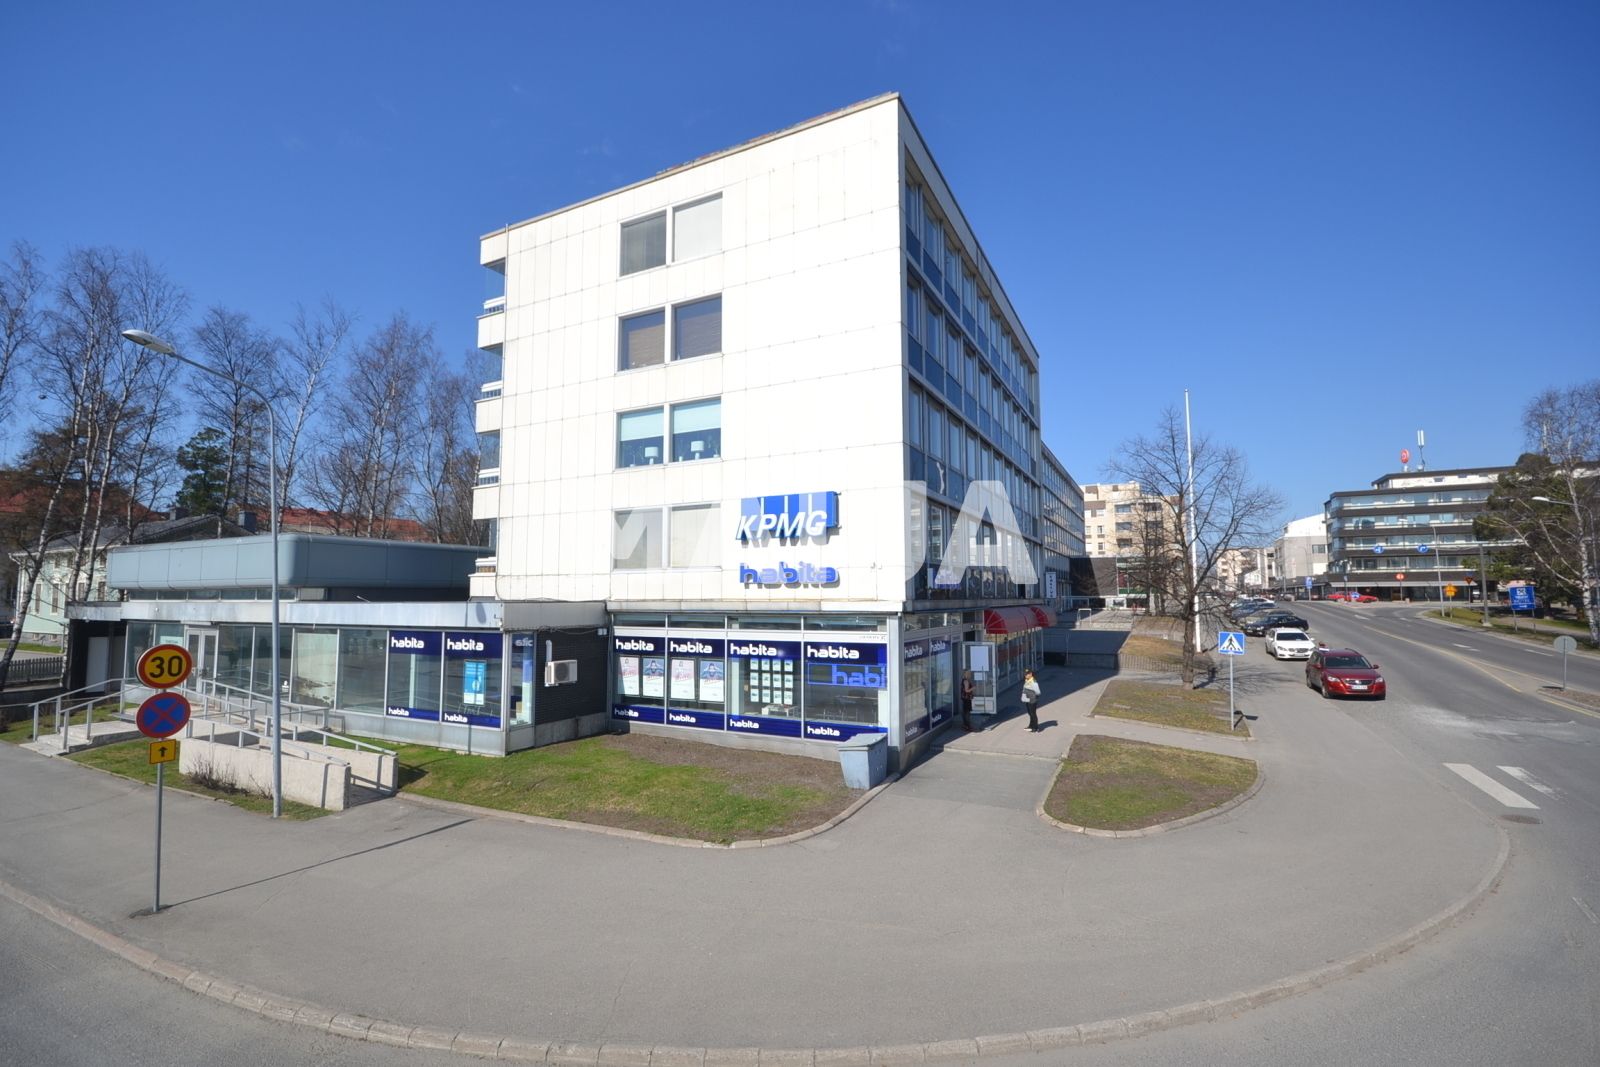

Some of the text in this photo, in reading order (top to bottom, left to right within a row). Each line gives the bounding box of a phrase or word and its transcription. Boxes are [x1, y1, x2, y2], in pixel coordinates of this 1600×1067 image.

[736, 510, 827, 540] KPMG
[740, 561, 837, 584] habita
[391, 637, 424, 649] habita
[447, 639, 484, 651] habita
[615, 639, 654, 651] habita
[670, 641, 712, 654] habita
[730, 643, 777, 656] habita
[807, 646, 860, 659] habita
[149, 655, 183, 678] 30
[388, 707, 410, 717] habita
[444, 713, 468, 723] habita
[614, 708, 639, 717] habita
[669, 713, 696, 723] habita
[729, 719, 759, 729] habita
[807, 726, 840, 737] habita
